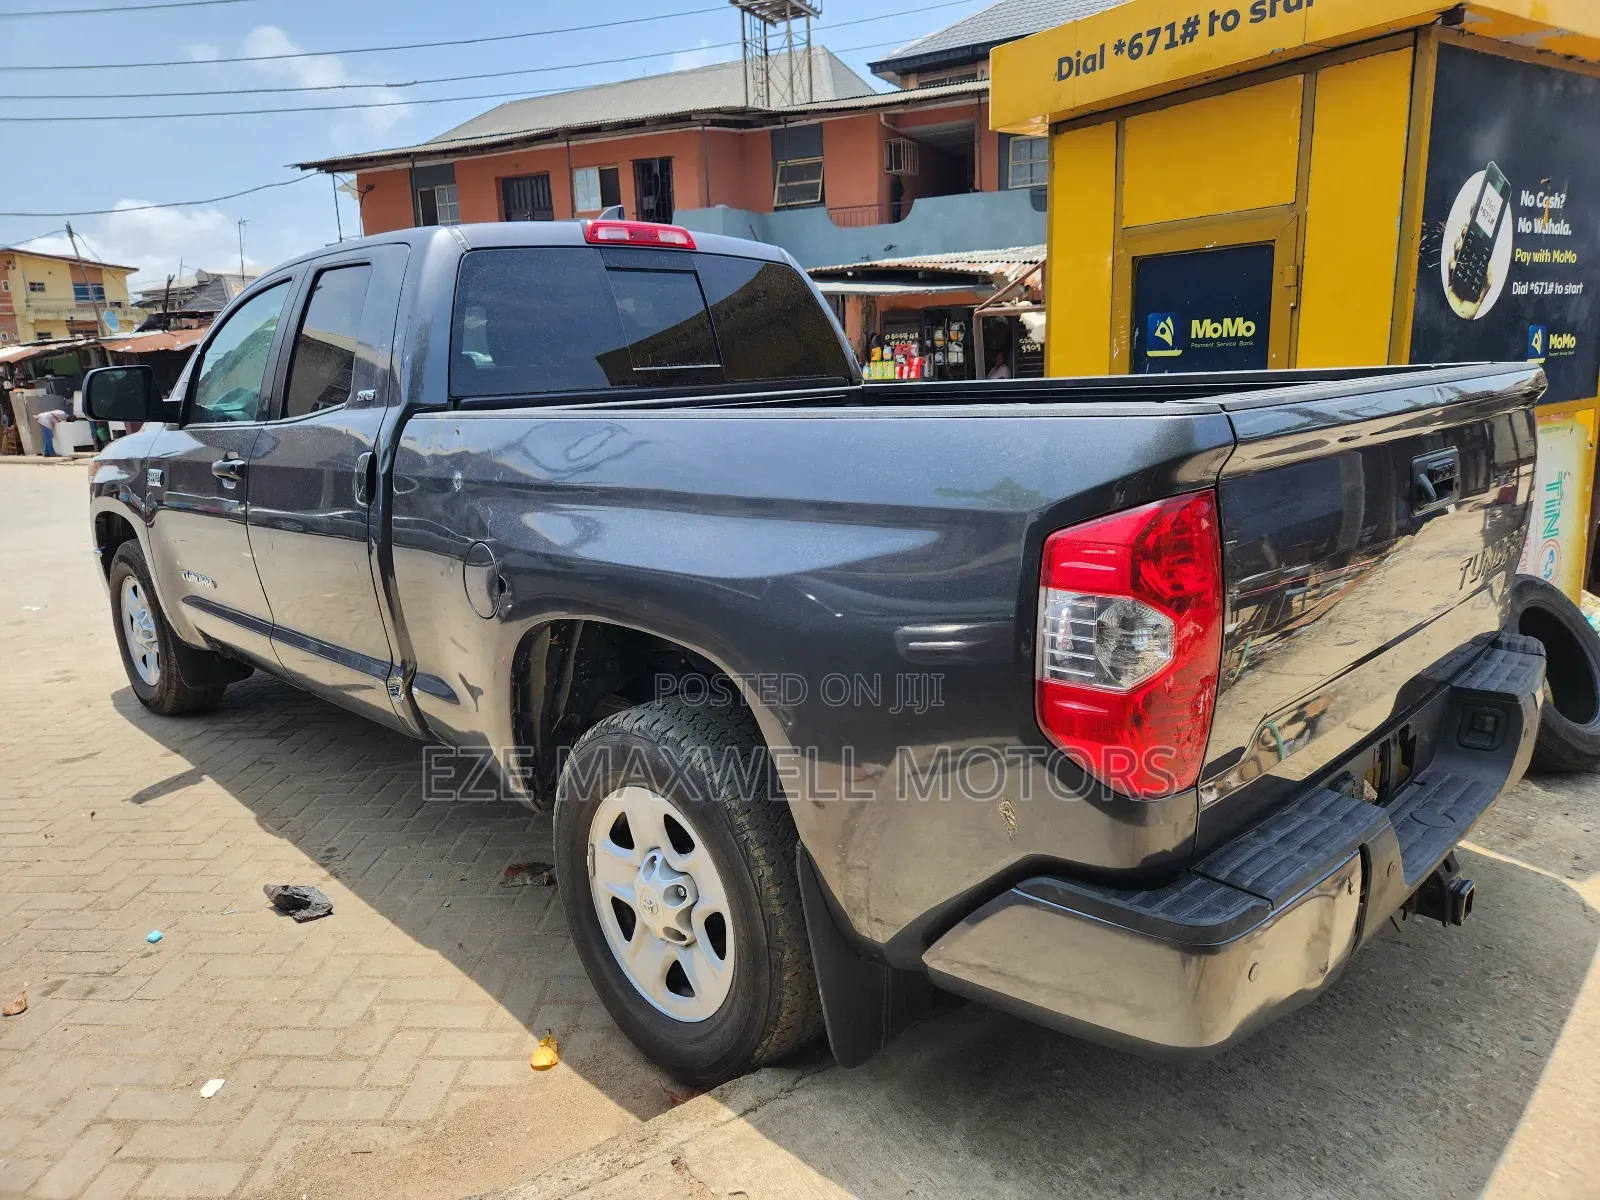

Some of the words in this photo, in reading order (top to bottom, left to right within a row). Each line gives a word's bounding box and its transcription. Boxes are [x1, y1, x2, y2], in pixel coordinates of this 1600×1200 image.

[1057, 43, 1106, 81] Dial
[1208, 9, 1241, 37] to
[1520, 190, 1535, 207] No
[1536, 191, 1566, 209] Cash?
[1517, 216, 1532, 234] No
[1534, 218, 1572, 236] Wahala.
[1514, 248, 1532, 266] Pay
[1533, 248, 1550, 262] with
[1552, 249, 1577, 264] MoMo
[1512, 281, 1528, 295] Dial
[1554, 282, 1563, 295] to
[1564, 282, 1584, 295] start
[1190, 316, 1256, 339] MoMo
[1549, 333, 1576, 349] MoMo
